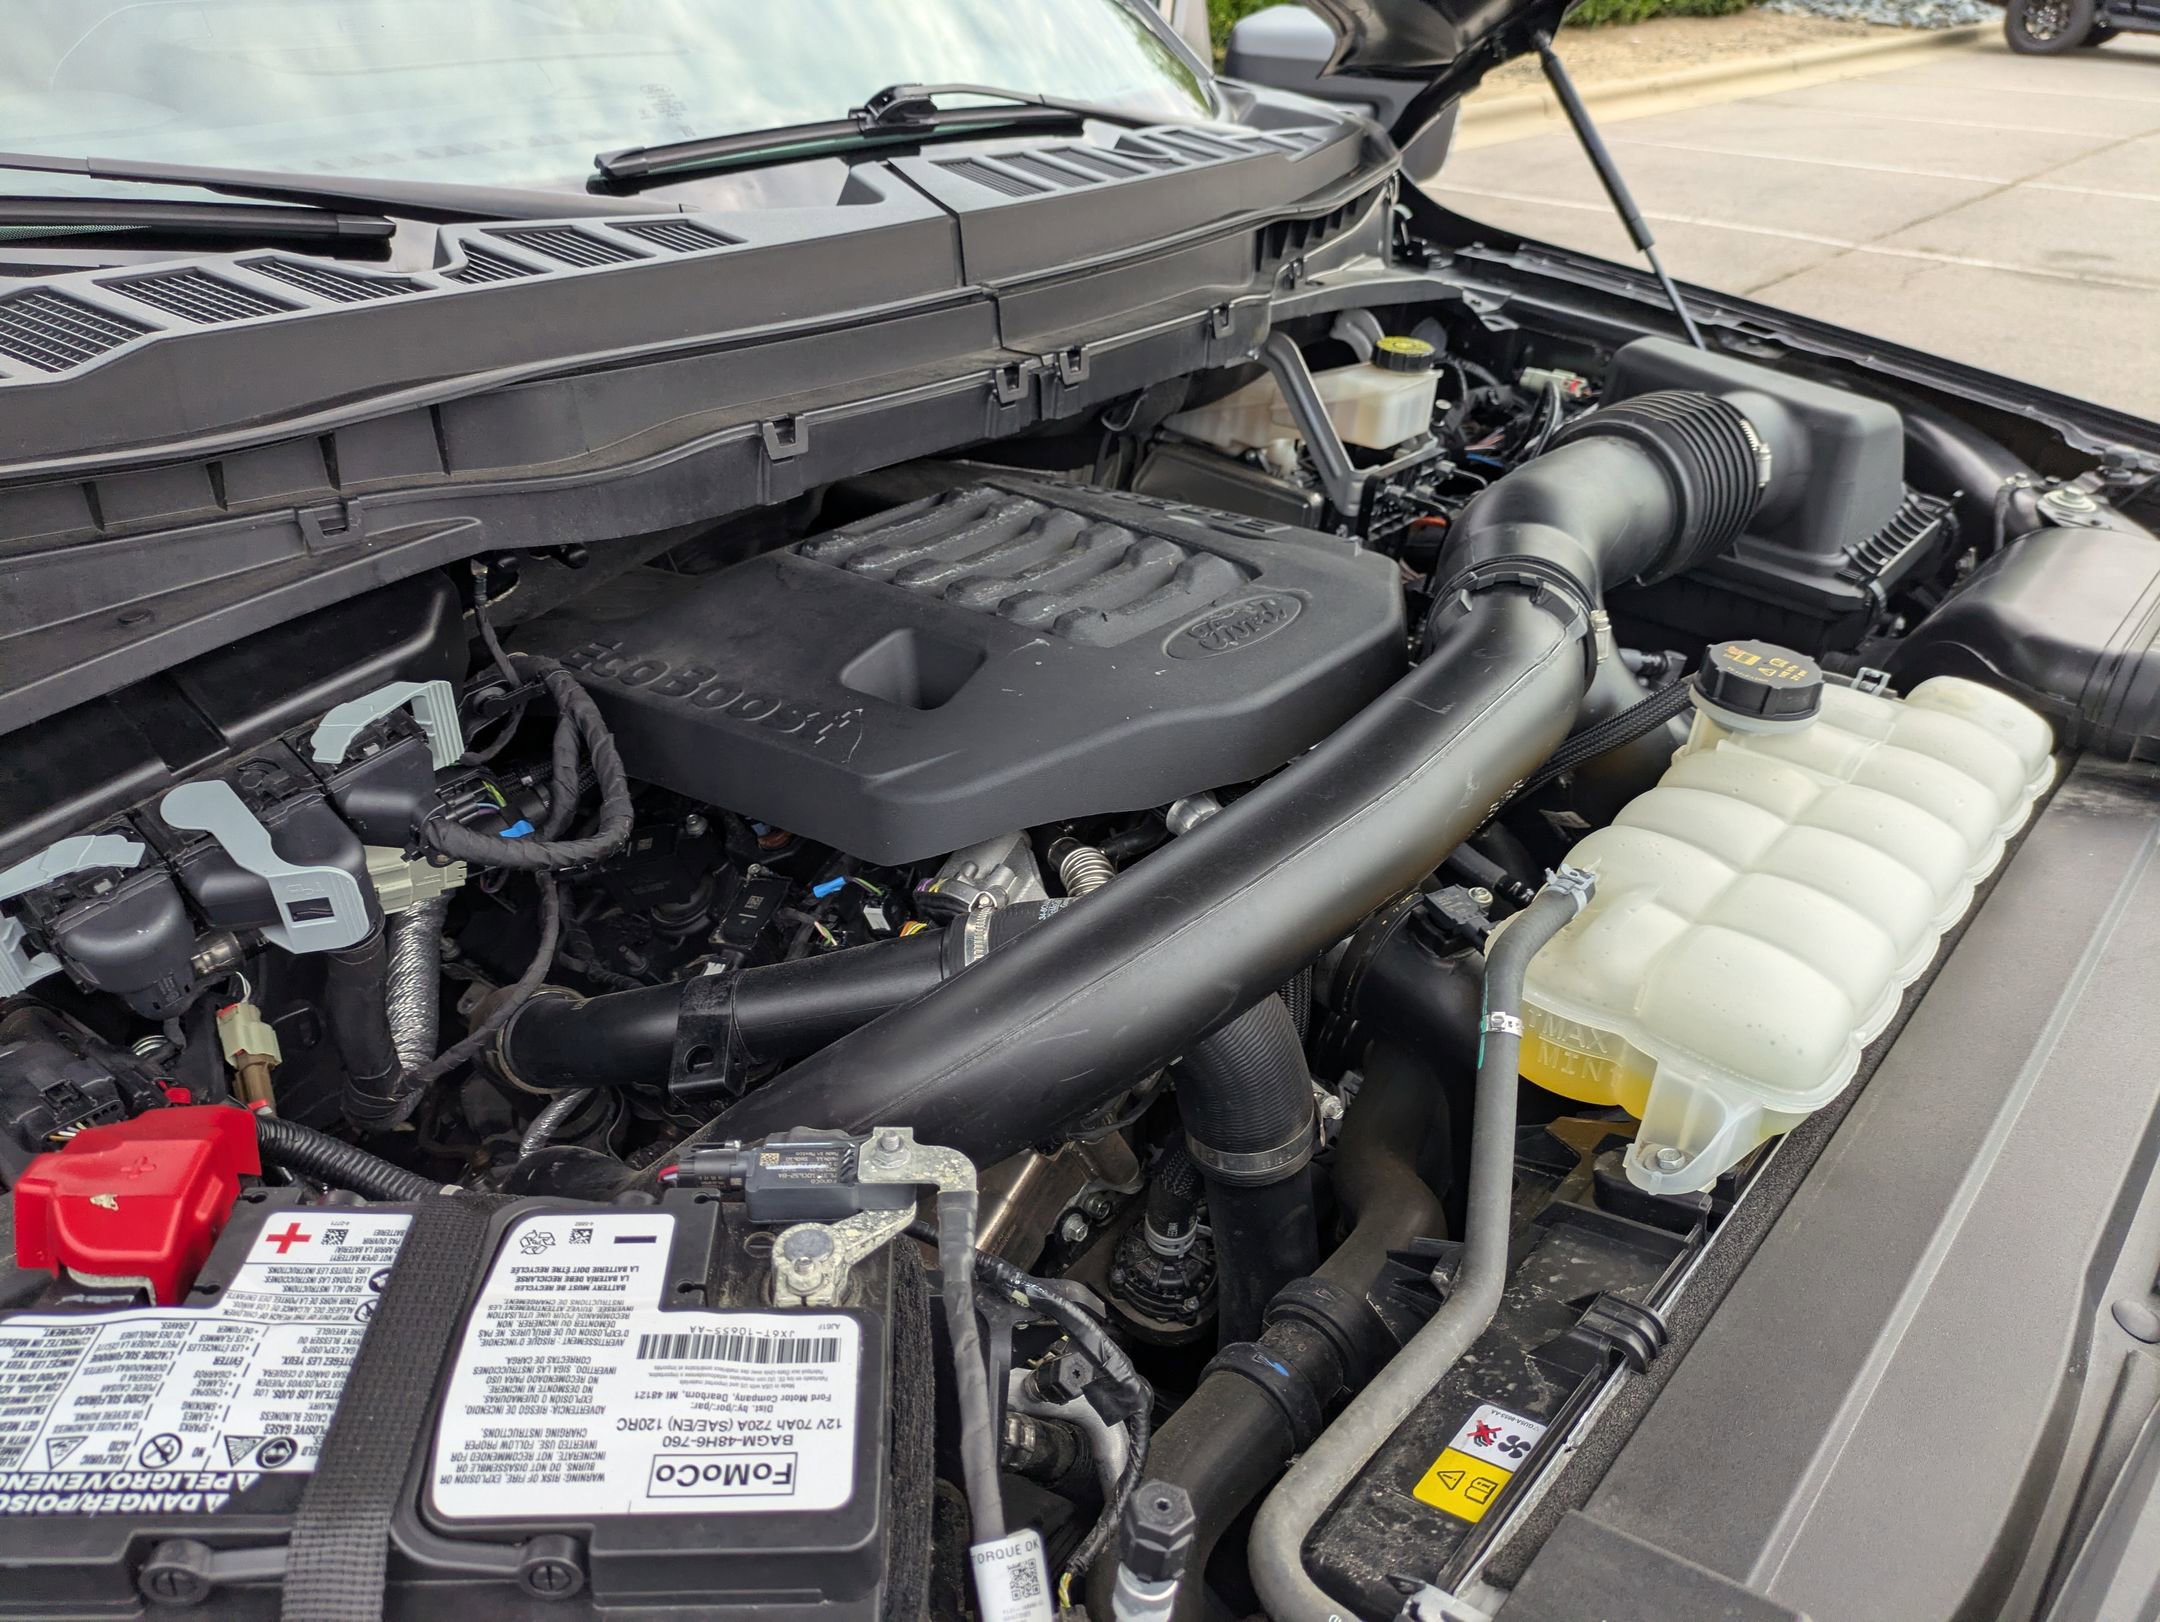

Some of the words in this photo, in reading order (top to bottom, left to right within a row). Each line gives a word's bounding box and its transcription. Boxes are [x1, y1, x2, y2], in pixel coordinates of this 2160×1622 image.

[566, 641, 852, 744] ECOBOOST
[1542, 1013, 1608, 1054] MAX
[1538, 1042, 1604, 1082] MIN
[689, 1325, 795, 1338] JX6T-10655-AA
[322, 1357, 356, 1367] OTÉGEZ
[533, 1356, 545, 1364] DE
[545, 1356, 591, 1364] CORRECTAS
[472, 1366, 534, 1374] INSTRUCCIONES
[535, 1366, 551, 1374] LAS
[552, 1366, 571, 1374] SIGA
[485, 1376, 502, 1384] USO
[503, 1376, 525, 1384] PARA
[525, 1376, 586, 1384] RECOMENDADO
[586, 1376, 599, 1384] NO
[526, 1385, 536, 1393] NI
[536, 1385, 580, 1393] DESMONTE
[580, 1385, 594, 1393] NO
[313, 1390, 343, 1399] OTEJA
[633, 1391, 663, 1400] 48121
[664, 1391, 678, 1400] MI
[682, 1391, 728, 1400] Dearborn,
[731, 1392, 778, 1401] Company,
[779, 1393, 808, 1402] Motor
[809, 1393, 832, 1402] Ford
[505, 1405, 517, 1414] DE
[517, 1405, 548, 1414] RIESGO
[615, 1419, 662, 1430] 120RC
[666, 1418, 733, 1430] (SAE/EN)
[736, 1418, 772, 1430] 720A
[776, 1418, 812, 1429] 70Ah
[816, 1418, 841, 1429] 12V
[293, 1424, 329, 1434] PLOSIVE
[544, 1428, 587, 1437] CHARGING
[463, 1440, 498, 1450] PROPER
[498, 1440, 534, 1449] FOLLOW
[556, 1440, 598, 1449] INVERTED
[661, 1435, 794, 1447] BAGM-48H6-760
[449, 1452, 468, 1462] FOR
[468, 1452, 534, 1461] RECOMMENDED
[535, 1452, 553, 1461] NOT
[455, 1464, 468, 1472] OR
[469, 1463, 528, 1472] DISASSEMBLE
[529, 1463, 547, 1472] NOT
[548, 1463, 562, 1472] DO
[438, 1475, 453, 1484] OR
[453, 1474, 502, 1484] EXPLOSION
[526, 1474, 539, 1483] OF
[540, 1473, 561, 1483] RISK
[654, 1463, 795, 1488] FoMoCo
[1025, 1538, 1040, 1552] OK
